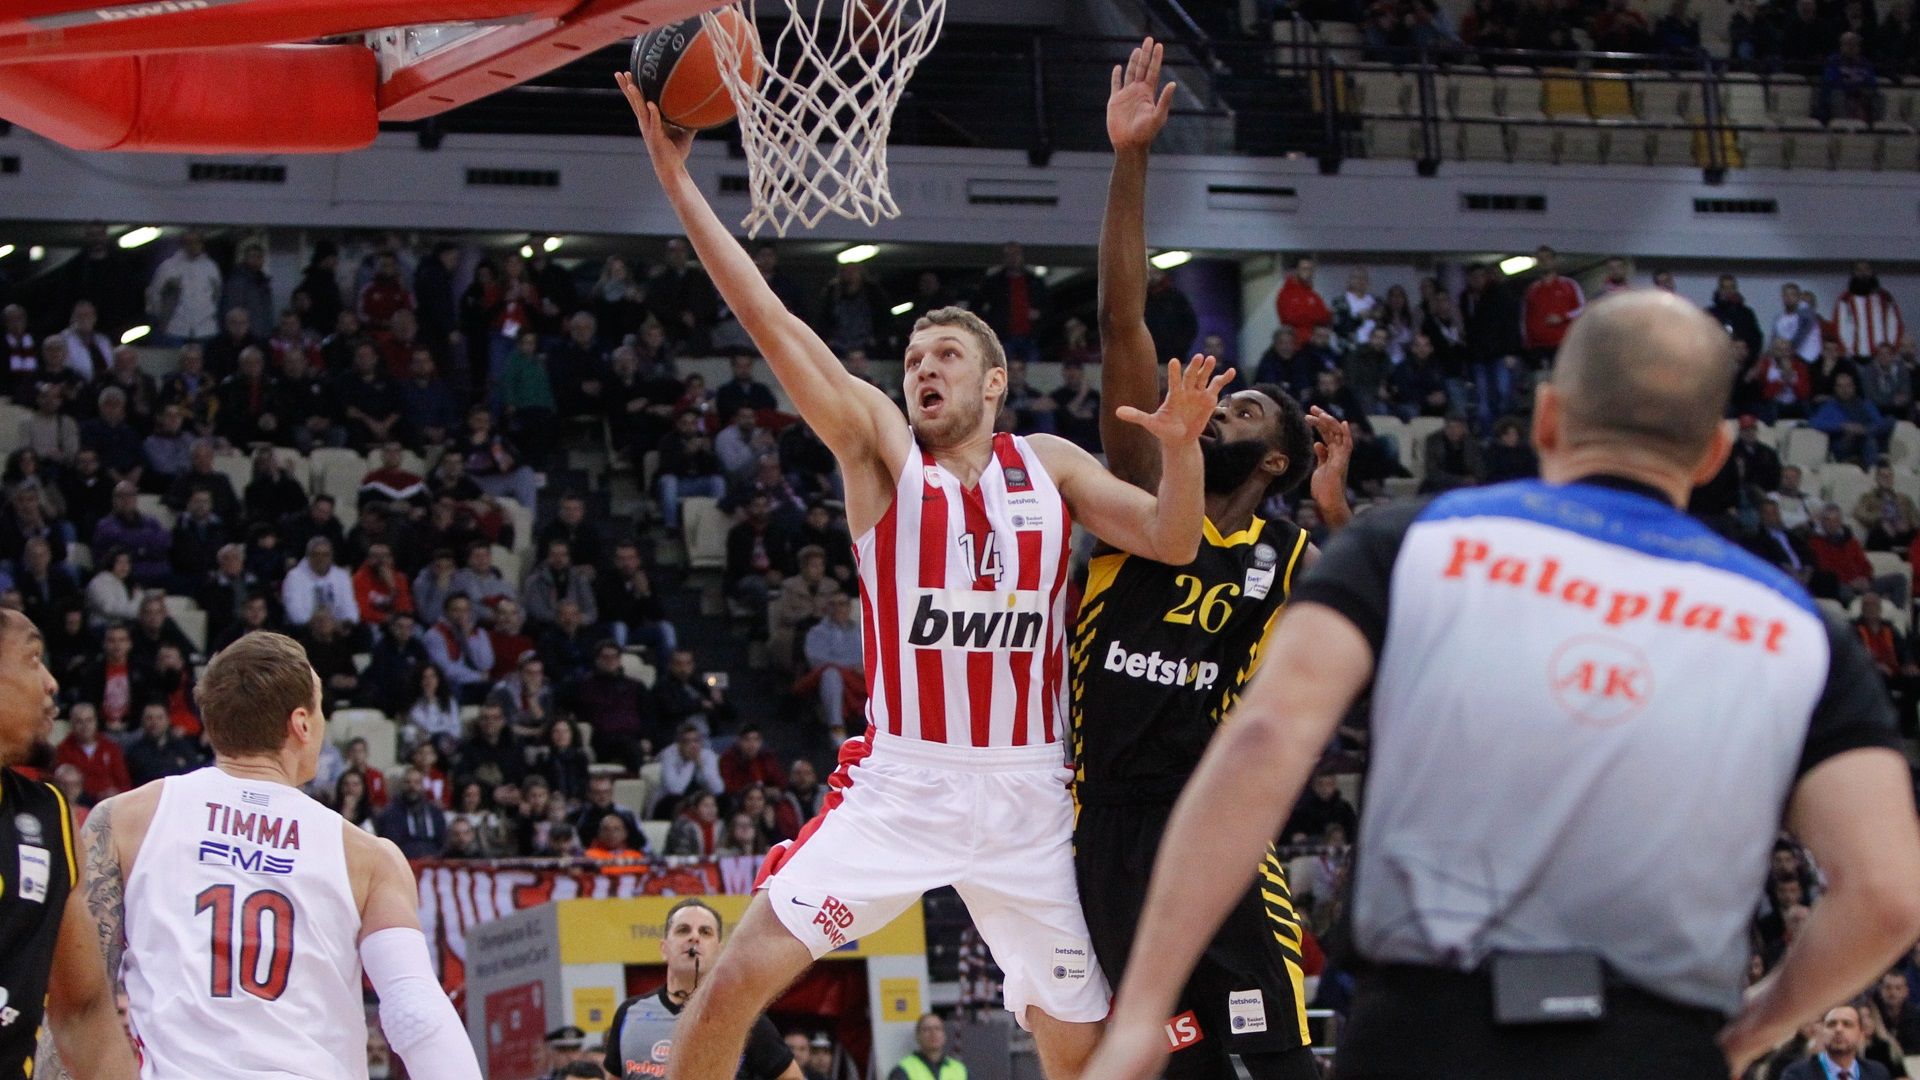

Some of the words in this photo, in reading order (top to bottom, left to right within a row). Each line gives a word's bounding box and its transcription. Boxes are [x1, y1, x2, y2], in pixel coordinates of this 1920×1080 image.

[642, 21, 683, 80] LDING
[958, 531, 1005, 582] 14
[908, 593, 1043, 648] bwin
[1163, 574, 1241, 633] 26
[1443, 537, 1787, 654] Palaplast
[206, 802, 300, 850] TIMMA
[199, 840, 295, 874] FMS
[812, 910, 847, 949] POWE
[821, 895, 854, 929] RED
[194, 884, 295, 1001] 10
